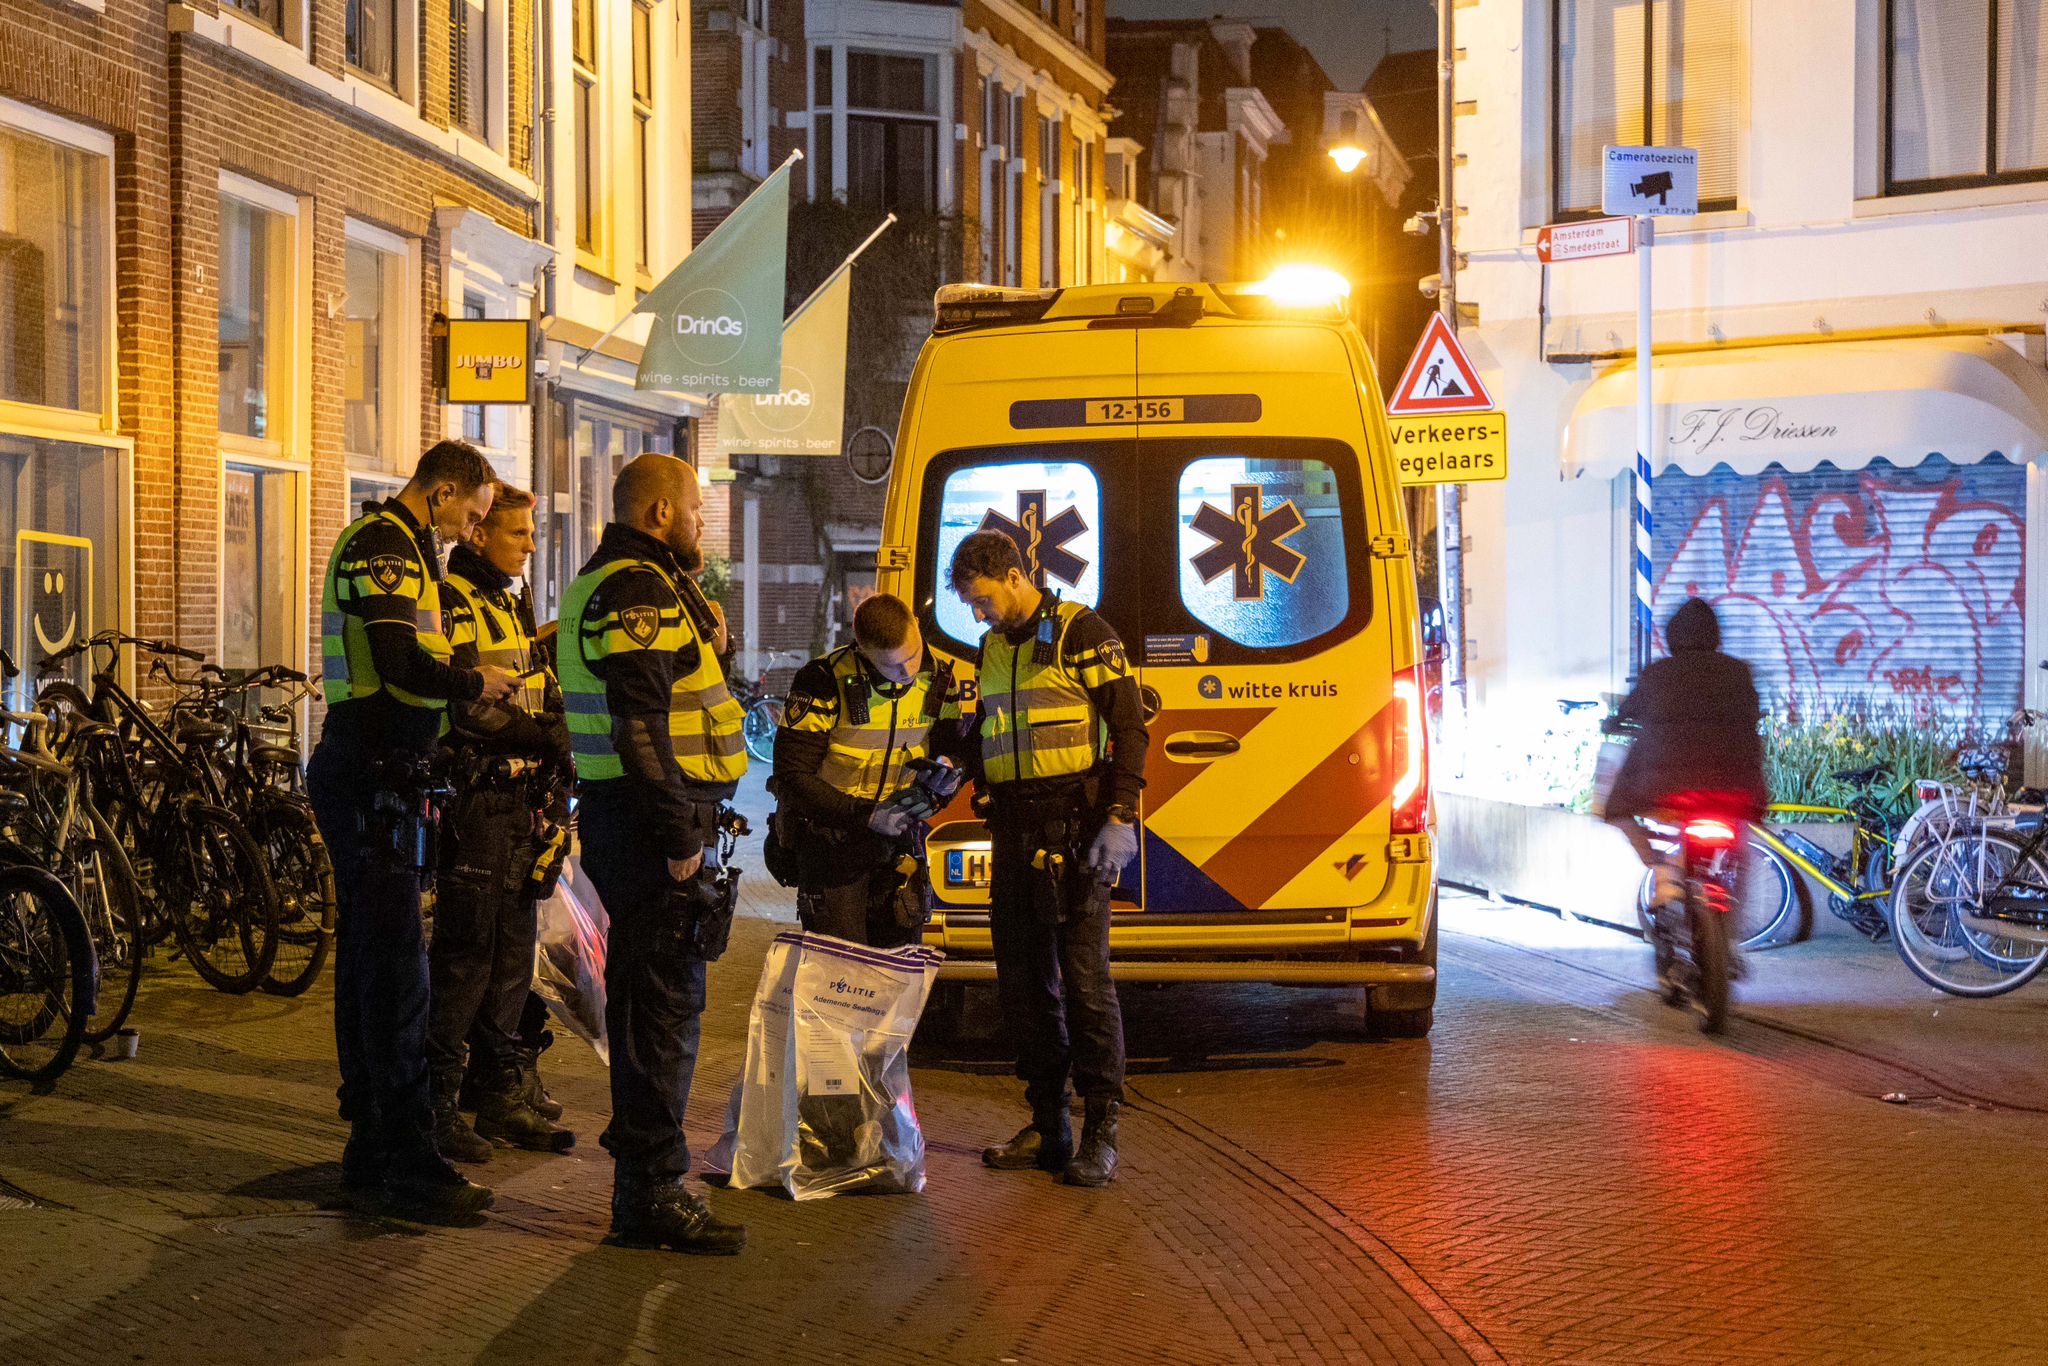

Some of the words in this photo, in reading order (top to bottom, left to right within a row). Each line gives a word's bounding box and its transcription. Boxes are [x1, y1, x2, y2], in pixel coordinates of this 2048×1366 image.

[1608, 150, 1694, 165] Cameratoezicht
[1553, 228, 1604, 241] Amsterdam
[1562, 239, 1620, 254] Smedestraat
[677, 314, 743, 337] DrinQs
[455, 353, 522, 370] JUMBO
[640, 371, 672, 385] wine
[682, 372, 730, 388] spirits
[739, 375, 774, 388] beer
[1100, 402, 1171, 420] 12-156
[1740, 406, 1838, 441] Driessen
[1390, 424, 1500, 445] Verkeers-
[723, 438, 751, 449] wine
[758, 437, 799, 450] spirits
[807, 439, 837, 449] beer
[1397, 451, 1494, 477] egelaars
[1228, 682, 1283, 699] witte
[1289, 680, 1338, 698] kruis
[951, 868, 962, 876] NL
[829, 977, 876, 999] POLITIE
[813, 995, 851, 1009] Ademende
